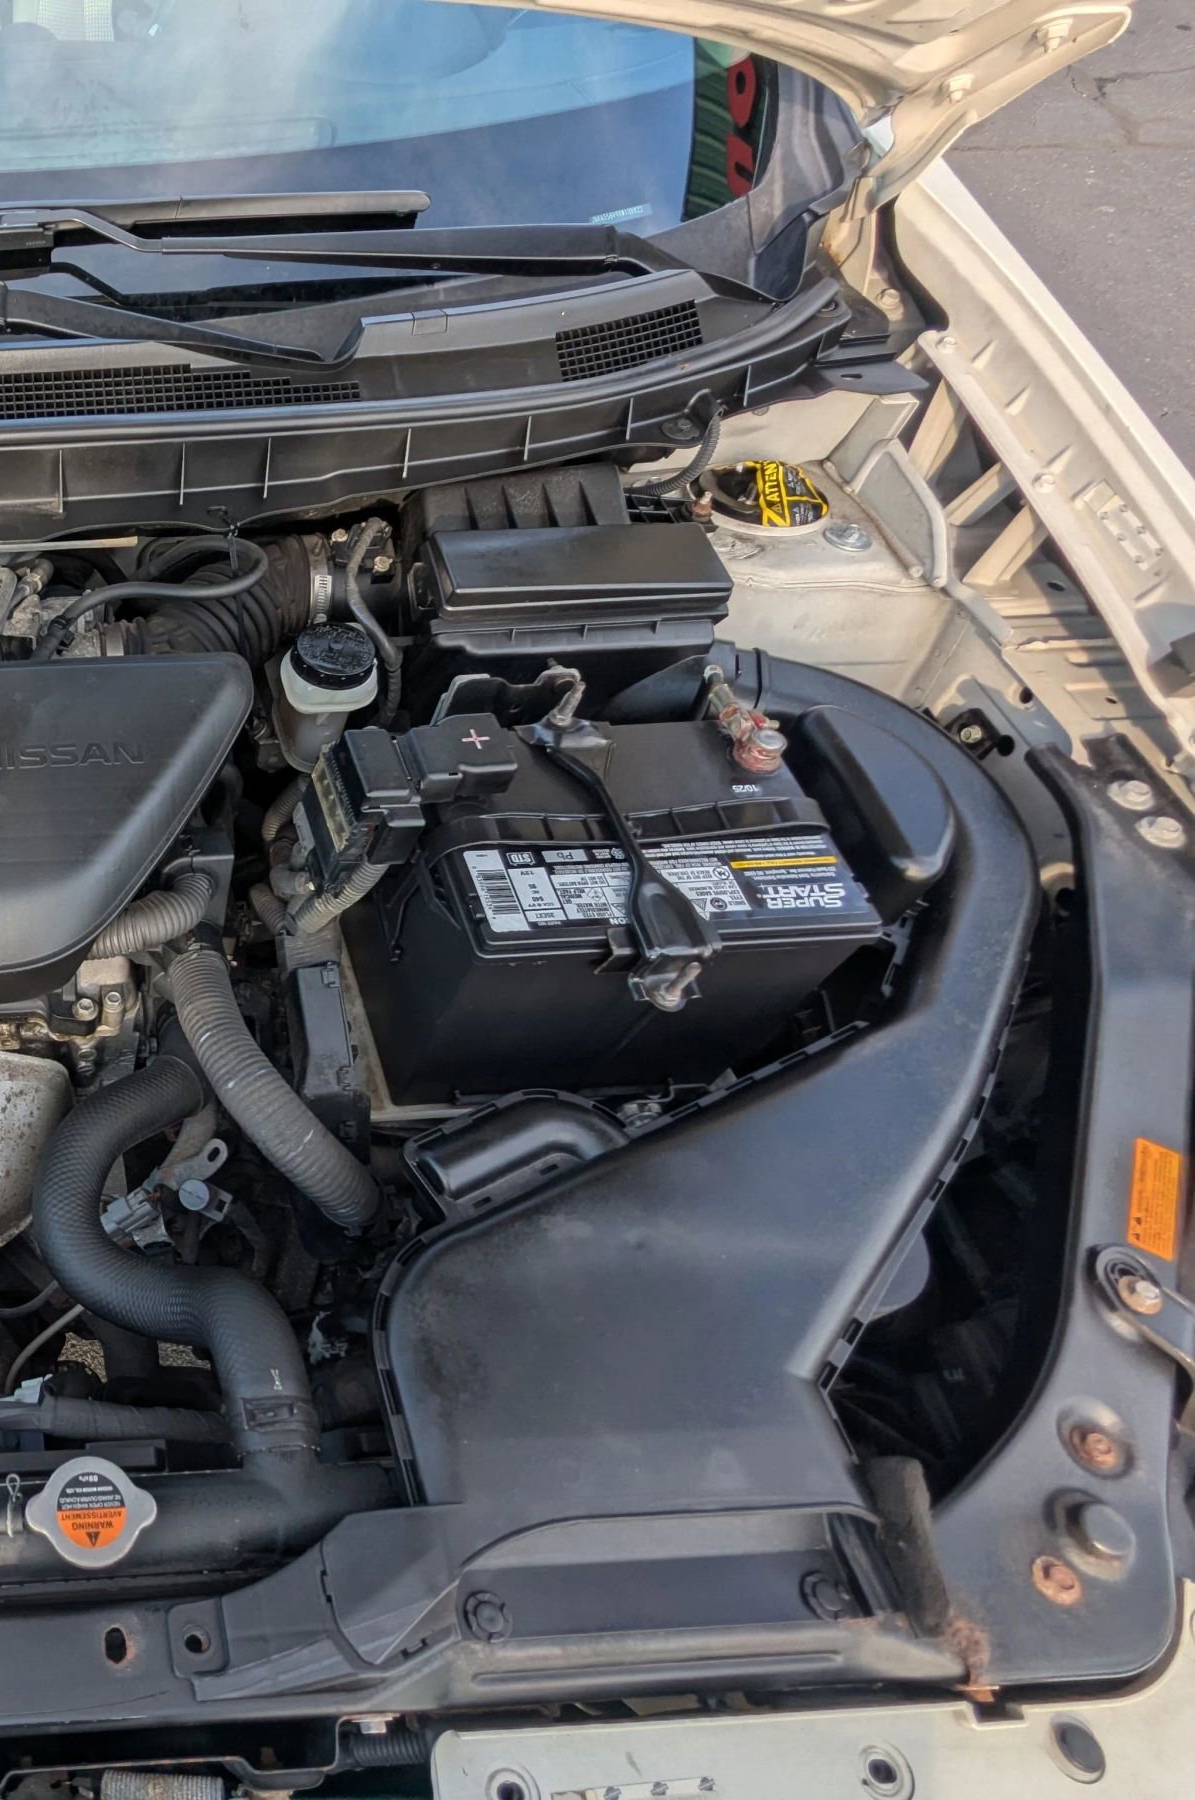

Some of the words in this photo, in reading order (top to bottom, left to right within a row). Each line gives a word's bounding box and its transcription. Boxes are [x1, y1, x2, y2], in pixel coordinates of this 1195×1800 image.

[732, 784, 760, 792] 10/25
[510, 854, 531, 862] STD
[763, 883, 846, 898] START
[766, 895, 843, 909] SUPER
[61, 1510, 122, 1520] AVERTISSEMENT
[71, 1520, 113, 1530] WARNING
